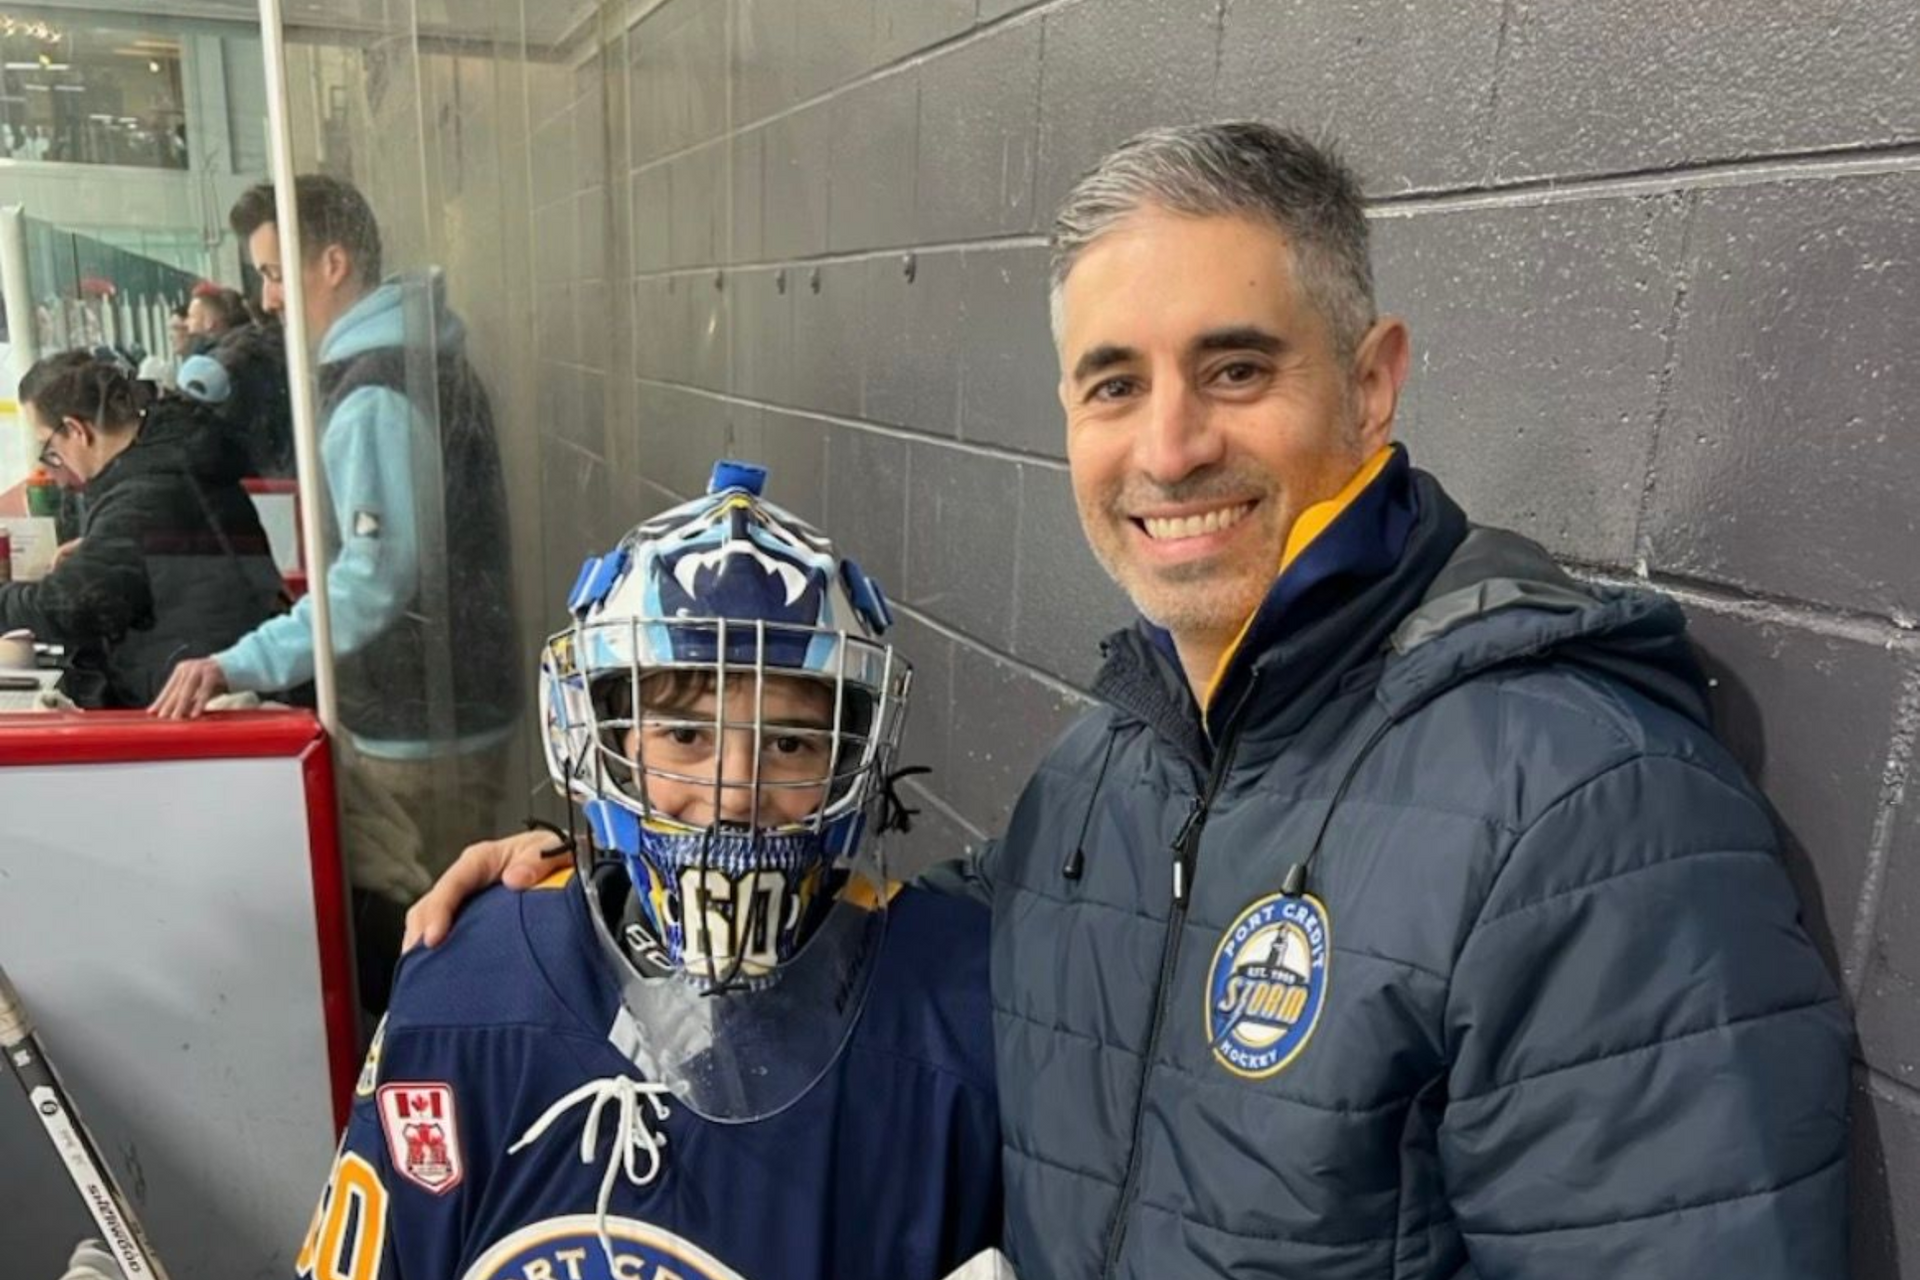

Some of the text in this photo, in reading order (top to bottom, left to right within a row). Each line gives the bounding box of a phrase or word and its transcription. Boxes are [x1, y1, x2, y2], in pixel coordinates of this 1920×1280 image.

[681, 869, 786, 978] 60
[1224, 903, 1325, 968] PORT CREDIT
[1217, 976, 1309, 1025] STORM
[1220, 1039, 1279, 1069] HOCKEY
[87, 1183, 141, 1273] SHERWOOD
[296, 1149, 389, 1280] 0
[510, 1247, 586, 1280] RT
